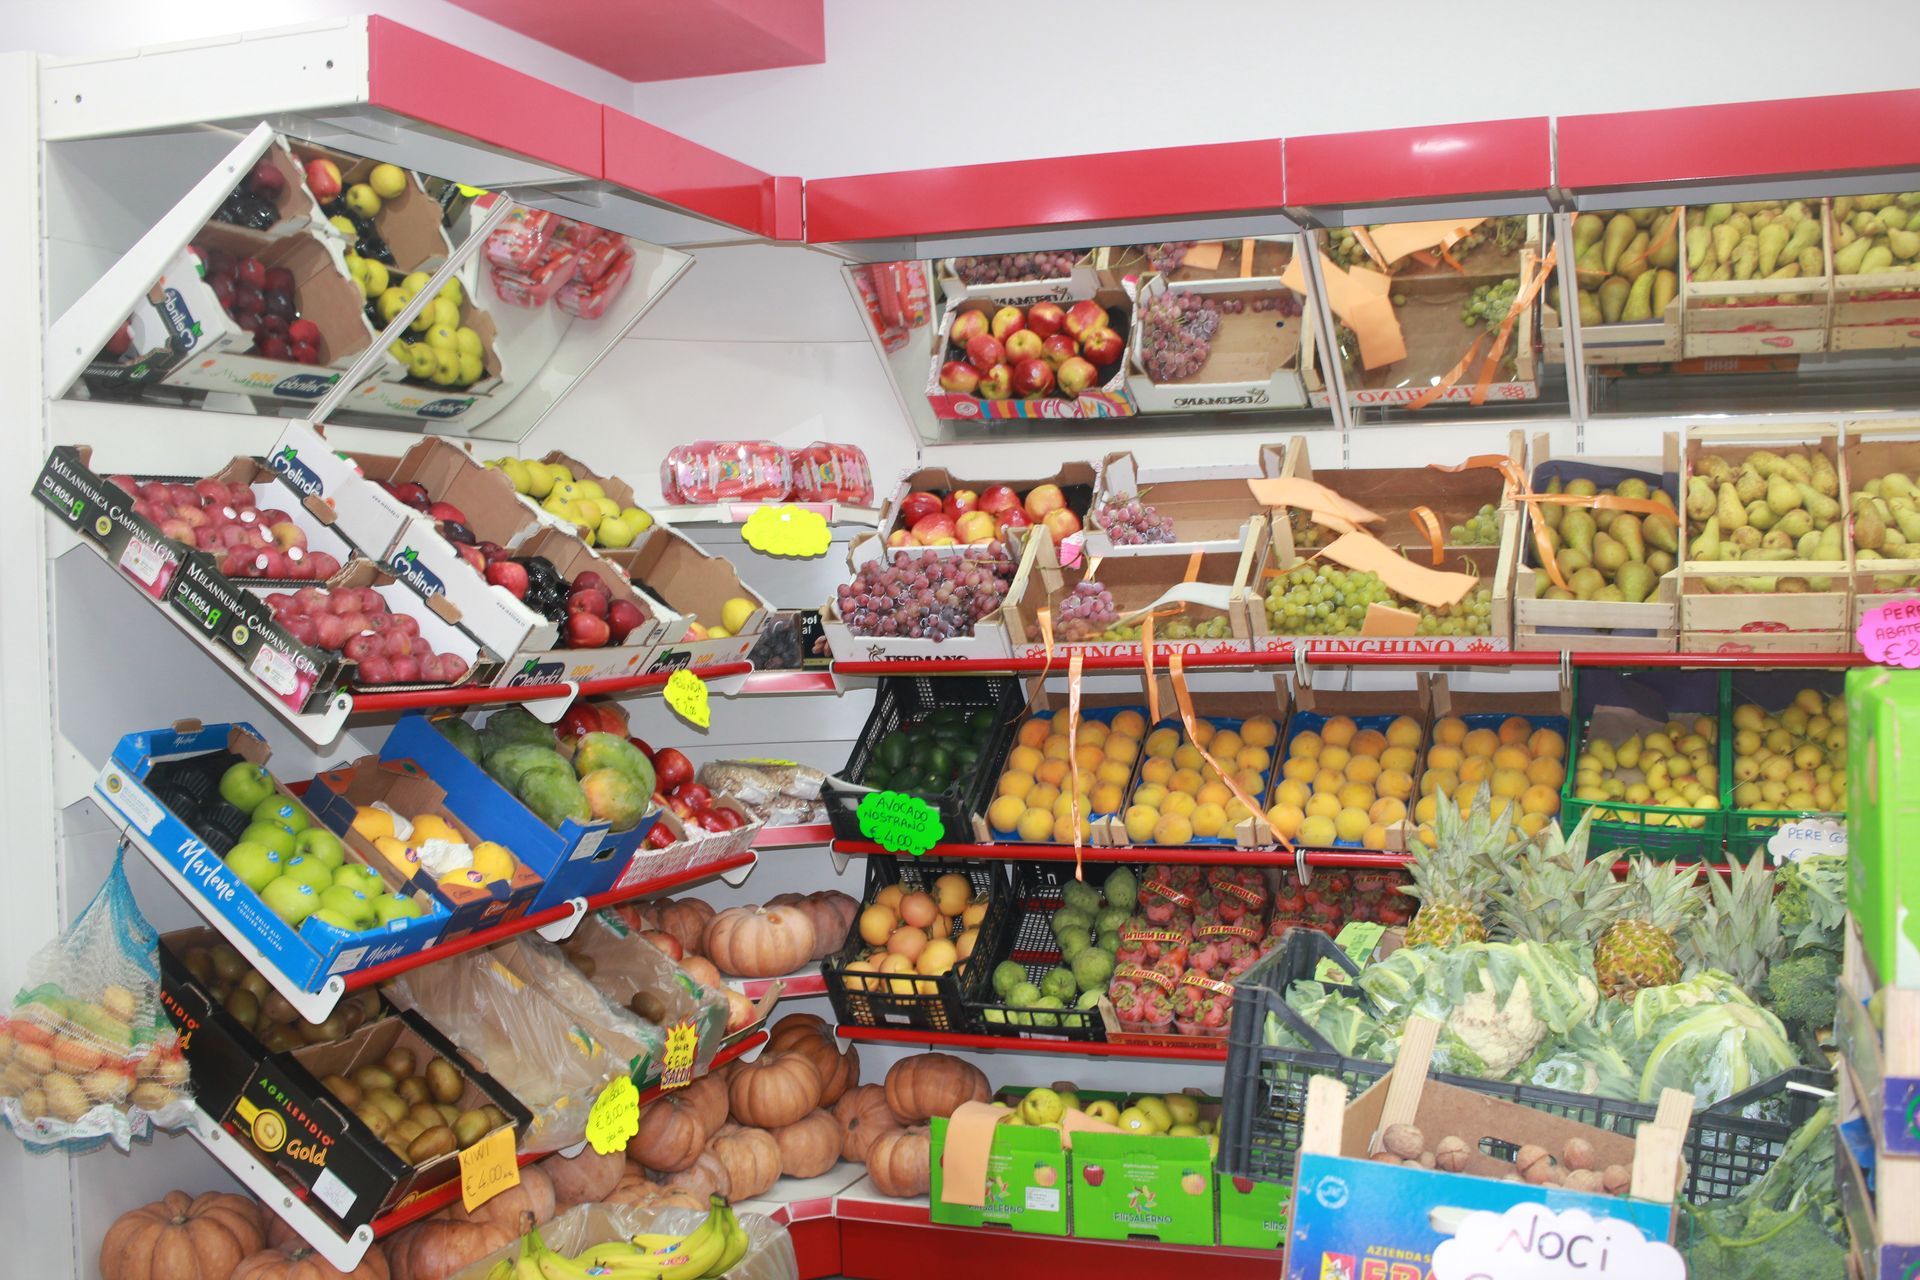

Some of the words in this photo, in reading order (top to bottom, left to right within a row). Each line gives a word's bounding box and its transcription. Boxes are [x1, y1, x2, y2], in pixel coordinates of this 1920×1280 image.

[50, 456, 109, 511] MELANNURCA
[109, 505, 152, 546] CAMPANA
[151, 540, 178, 562] IGP
[394, 556, 439, 598] Melind
[187, 562, 247, 620] MELANNURCA
[247, 614, 291, 656] CAMPANA
[290, 649, 316, 673] IGP
[864, 811, 925, 832] NOSTRANO
[876, 798, 928, 822] AVOCADO
[1788, 827, 1822, 841] PERE
[177, 838, 236, 902] Marlene
[259, 1077, 331, 1147] AGRILEPIDIO
[286, 1139, 328, 1167] Gold
[462, 1142, 489, 1168] KIWI
[1366, 1244, 1422, 1262] AZIENDA
